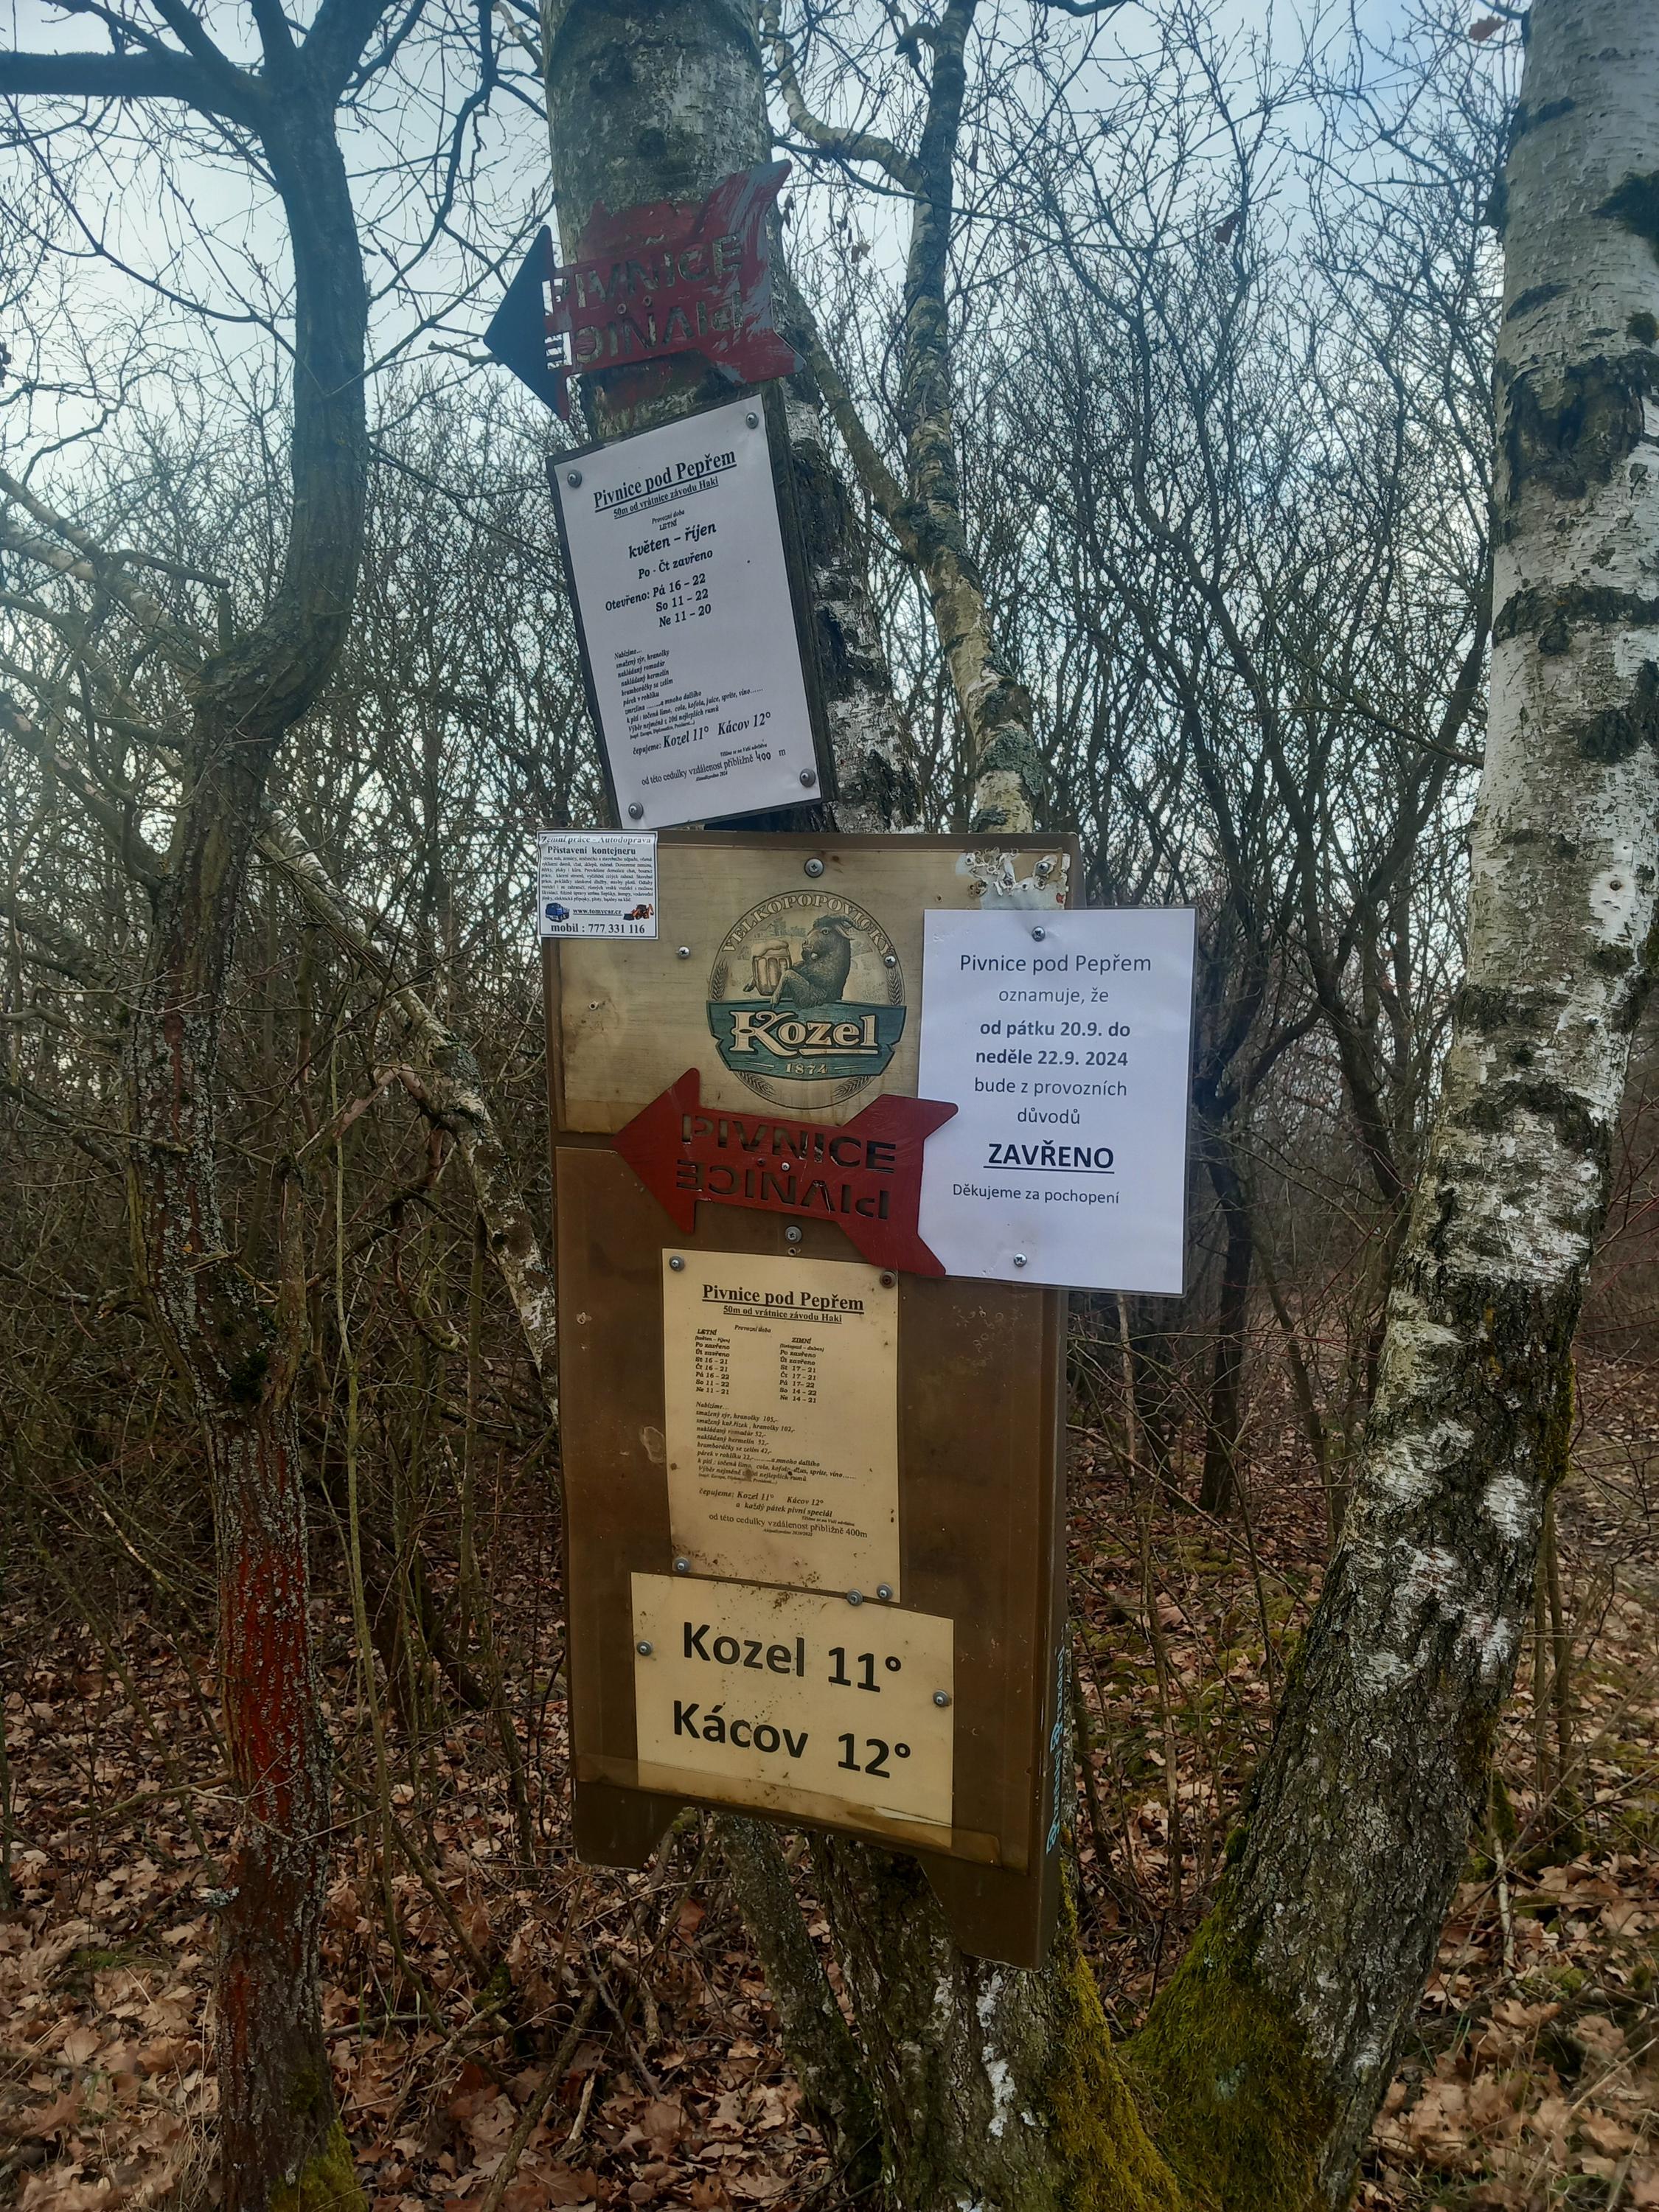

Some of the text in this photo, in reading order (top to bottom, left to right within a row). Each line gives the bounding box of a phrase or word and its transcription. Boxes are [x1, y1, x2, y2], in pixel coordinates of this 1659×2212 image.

[541, 234, 743, 316] PIVNICE
[593, 451, 736, 509] Pivnice pod Pepřem
[613, 507, 628, 518] 50m
[629, 501, 639, 512] od
[639, 493, 668, 507] vrátnice
[669, 483, 697, 498] závodu
[672, 509, 685, 518] doba
[627, 523, 717, 559] květen říjen
[638, 549, 713, 580] Po Čt zavřeno
[605, 572, 706, 611] Otevřeno: Pá 16 22
[655, 588, 708, 612] So 11 22
[658, 603, 712, 627] Ne 11 20
[632, 742, 661, 756] čepujeme:
[663, 730, 689, 748] Kozel
[692, 725, 709, 741] 11°
[717, 720, 749, 735] Kácov
[753, 711, 771, 727] 12°
[641, 776, 650, 785] od
[649, 774, 662, 784] této
[662, 768, 687, 781] cedulky
[688, 761, 723, 775] vzdálenost
[723, 754, 754, 770] přibližně
[754, 750, 771, 762] 400
[778, 748, 786, 757] m
[547, 845, 636, 856] Přistavení kontejneru
[550, 922, 644, 933] mobil 777 331 116
[961, 953, 1151, 975] Pivnice pod Pepřem
[998, 987, 1109, 1006] oznamuje, že
[729, 1010, 878, 1057] Kozel
[980, 1020, 1130, 1039] od pátku 20.9. do
[785, 1062, 828, 1074] 1874
[975, 1048, 1128, 1066] neděle 22.9. 2024
[975, 1077, 1127, 1097] bude z provozních
[1017, 1107, 1080, 1124] důvodů
[681, 1113, 897, 1174] PIVNICE
[988, 1139, 1114, 1169] ZAVŘENO
[953, 1183, 1119, 1206] Děkujeme za pochopení
[702, 1284, 863, 1310] Pivnice pod Pepřem
[723, 1304, 740, 1314] 50m
[742, 1307, 752, 1315] od
[754, 1308, 787, 1318] vrátnice
[789, 1310, 818, 1321] závodu
[789, 1350, 816, 1358] zavřeno
[736, 1490, 759, 1500] Kozel
[786, 1495, 809, 1504] Kácov
[744, 1501, 765, 1512] každý
[765, 1504, 785, 1512] pátek
[786, 1506, 806, 1514] pivní
[807, 1509, 832, 1517] speciál
[708, 1512, 718, 1520] od
[719, 1514, 734, 1522] této
[735, 1516, 765, 1527] cedulky
[767, 1520, 808, 1530] vzdálenost
[809, 1523, 844, 1534] přibližně
[845, 1527, 867, 1538] 400m
[684, 1621, 902, 1693] Kozel 11°
[673, 1700, 911, 1779] Kácov 12°
